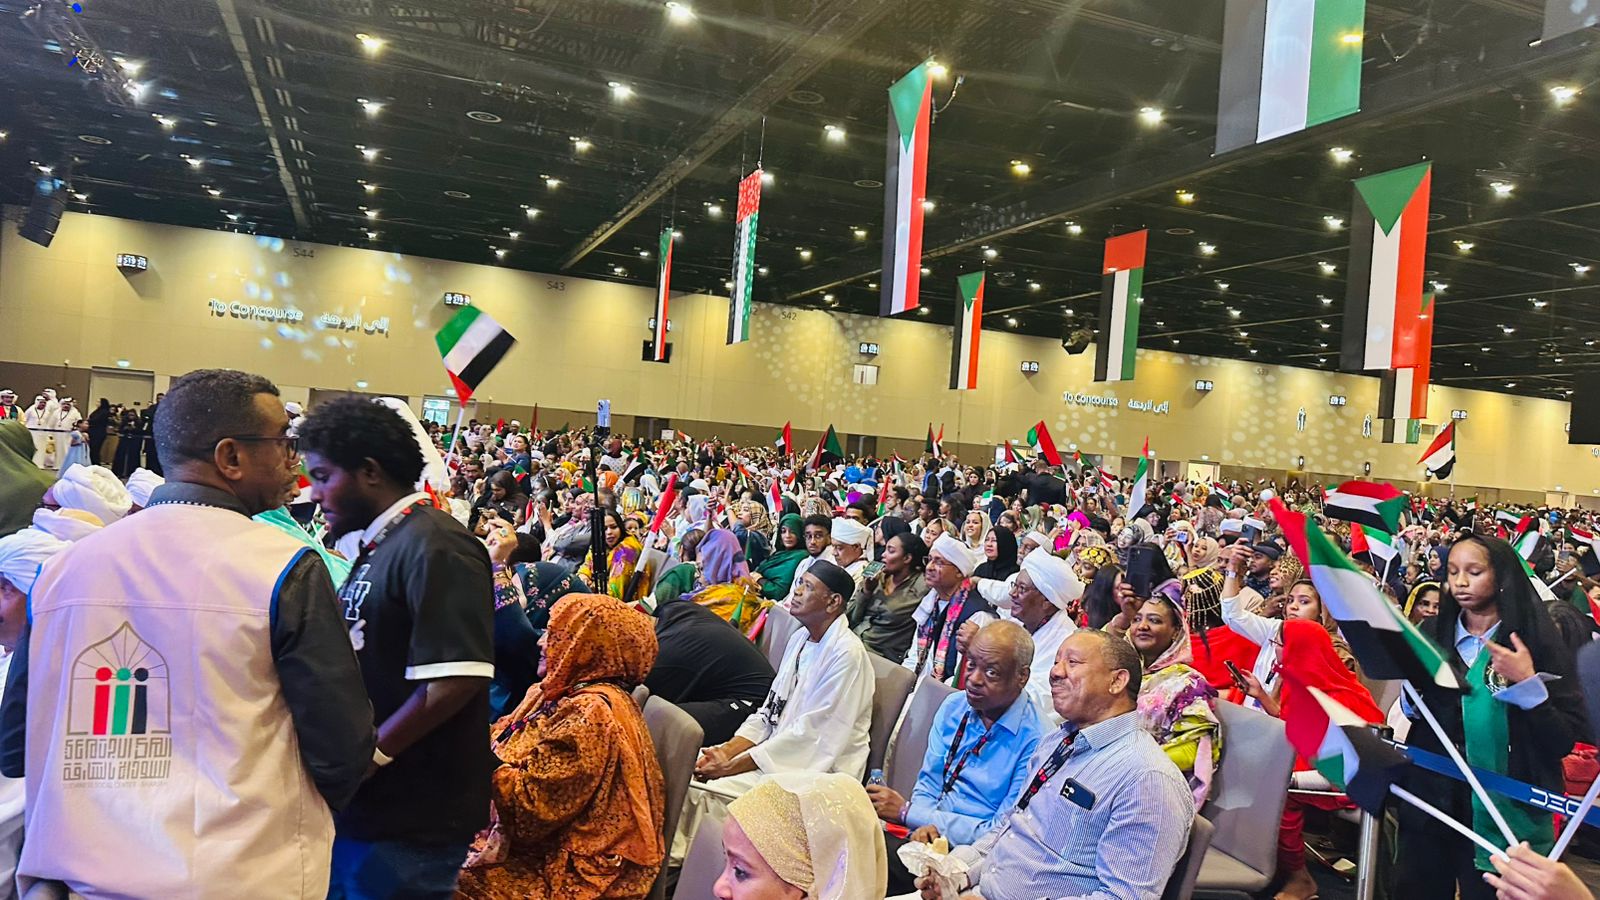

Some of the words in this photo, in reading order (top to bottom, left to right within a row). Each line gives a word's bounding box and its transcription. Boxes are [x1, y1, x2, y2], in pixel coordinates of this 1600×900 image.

[546, 280, 566, 291] S43
[208, 298, 226, 313] To
[229, 301, 304, 321] Concourse
[781, 311, 797, 321] S42
[1075, 394, 1119, 407] Concourse
